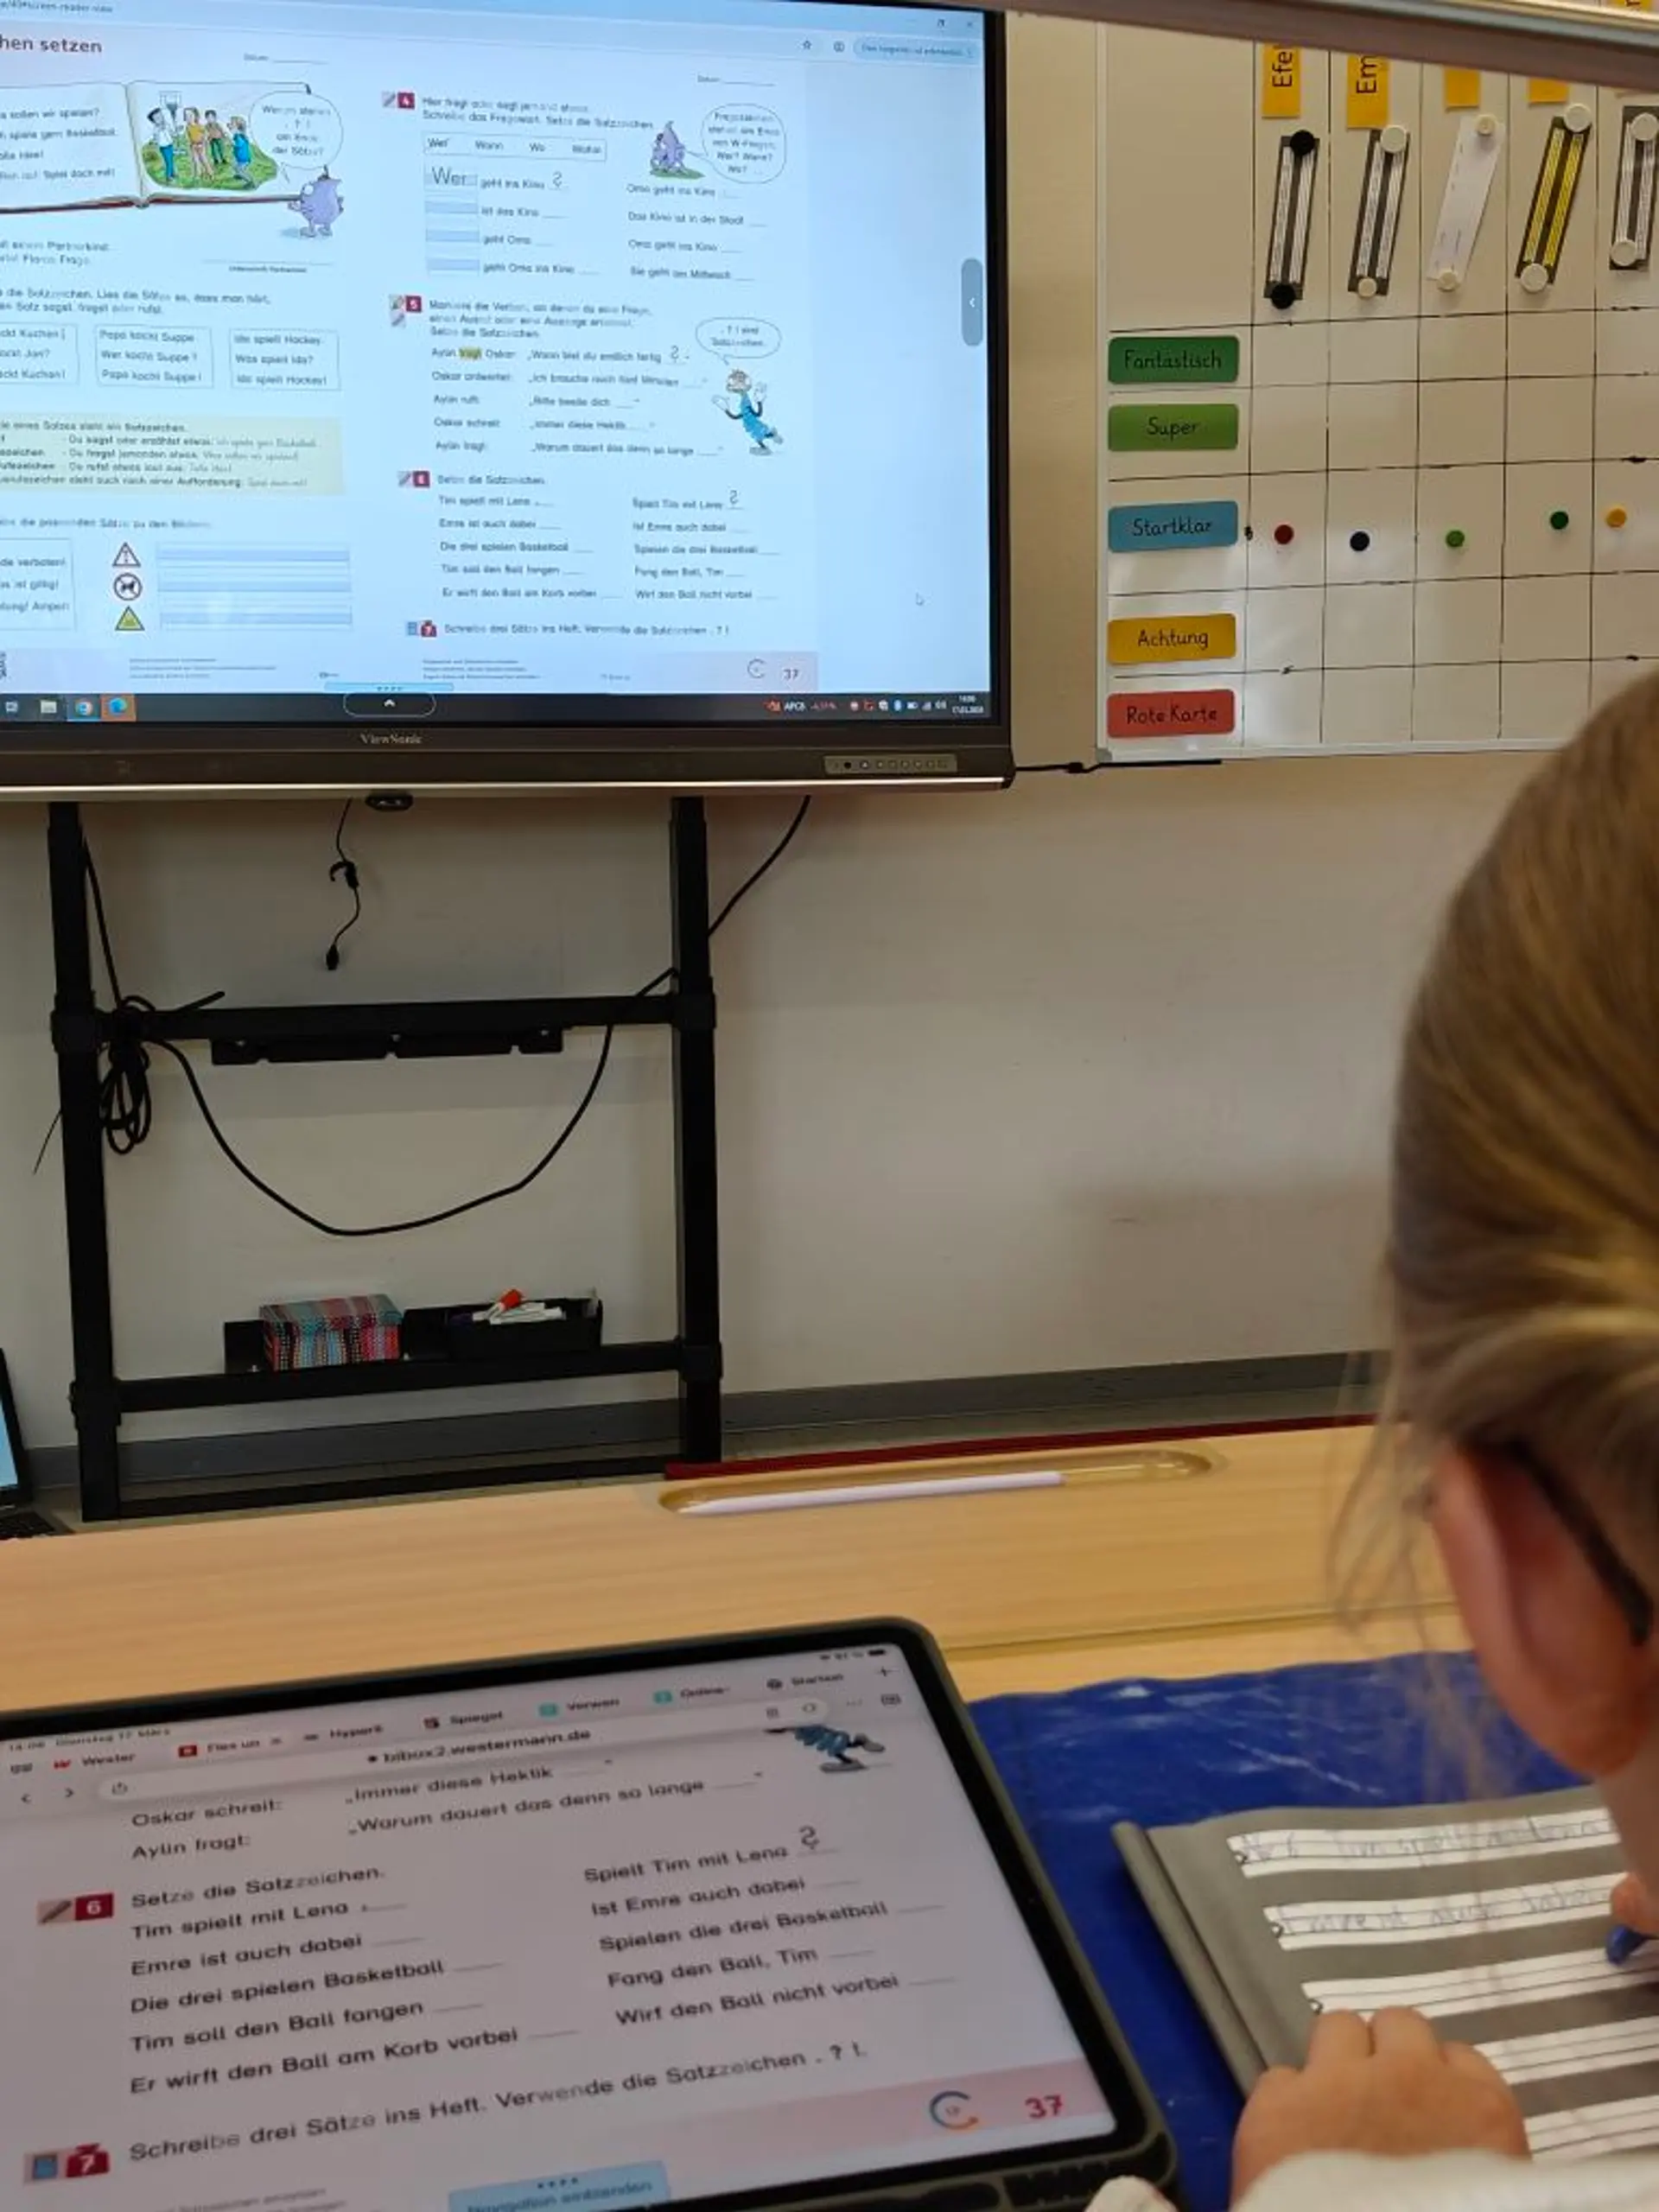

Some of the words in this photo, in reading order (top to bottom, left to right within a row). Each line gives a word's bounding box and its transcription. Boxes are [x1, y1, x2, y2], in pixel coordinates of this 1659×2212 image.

[40, 39, 103, 53] setzen
[432, 167, 468, 186] Wer
[1124, 348, 1223, 371] Fantastisch
[1147, 416, 1199, 442] Super
[1132, 518, 1213, 537] Startklar
[1136, 619, 1210, 651] Achtung
[1126, 705, 1166, 724] Rote
[1169, 702, 1217, 723] Karte
[428, 1773, 483, 1792] diese
[489, 1768, 554, 1786] Hektik
[131, 1809, 196, 1827] Oskar
[440, 1801, 508, 1823] dauert
[515, 1796, 553, 1815] das
[559, 1788, 611, 1808] denn
[618, 1787, 642, 1801] so
[648, 1780, 705, 1800] lange
[131, 1841, 187, 1860] Aylin
[583, 1863, 645, 1884] Spielt
[652, 1858, 691, 1874] Tim
[697, 1852, 730, 1868] mit
[734, 1845, 791, 1864] Lena
[130, 1889, 194, 1909] Setze
[203, 1881, 238, 1900] die
[591, 1901, 619, 1917] Ist
[625, 1893, 683, 1913] Emre
[689, 1885, 741, 1904] auch
[747, 1876, 805, 1897] dabei
[131, 1923, 173, 1941] Tim
[181, 1914, 243, 1936] spielt
[251, 1906, 285, 1925] mit
[294, 1902, 349, 1921] Lena
[599, 1930, 683, 1953] Spielen
[689, 1923, 721, 1940] die
[728, 1915, 770, 1935] drei
[776, 1901, 889, 1928] Basketball
[130, 1958, 192, 1977] Emre
[200, 1950, 228, 1968] ist
[235, 1942, 291, 1964] auch
[300, 1933, 363, 1956] dabei
[607, 1967, 664, 1988] Fang
[671, 1961, 713, 1980] den
[776, 1948, 819, 1967] Tim
[130, 1994, 169, 2014] Die
[178, 1986, 224, 2008] drei
[231, 1977, 316, 2003] spielen
[324, 1959, 445, 1989] Basketball
[614, 2004, 663, 2026] Wirf
[670, 2001, 714, 2020] den
[720, 1993, 765, 2012] Ball
[772, 1983, 826, 2005] nicht
[832, 1972, 899, 1996] vorbei
[130, 2034, 175, 2052] Tim
[183, 2025, 227, 2046] soll
[235, 2020, 280, 2039] den
[289, 2011, 335, 2032] Ball
[343, 1999, 424, 2024] fangen
[130, 2075, 156, 2095] Er
[166, 2068, 219, 2090] wirft
[227, 2061, 273, 2082] den
[282, 2052, 330, 2074] Ball
[338, 2045, 376, 2066] am
[383, 2037, 439, 2061] Korb
[447, 2024, 518, 2051] vorbei
[130, 2131, 241, 2162] Schreibe
[250, 2122, 297, 2146] drei
[305, 2110, 376, 2137] Sätze
[385, 2106, 422, 2125] ins
[429, 2094, 488, 2119] Heft.
[495, 2075, 615, 2108] Verwende
[621, 2069, 658, 2093] die
[665, 2050, 807, 2085] Satzzeichen
[1025, 2094, 1064, 2119] 37
